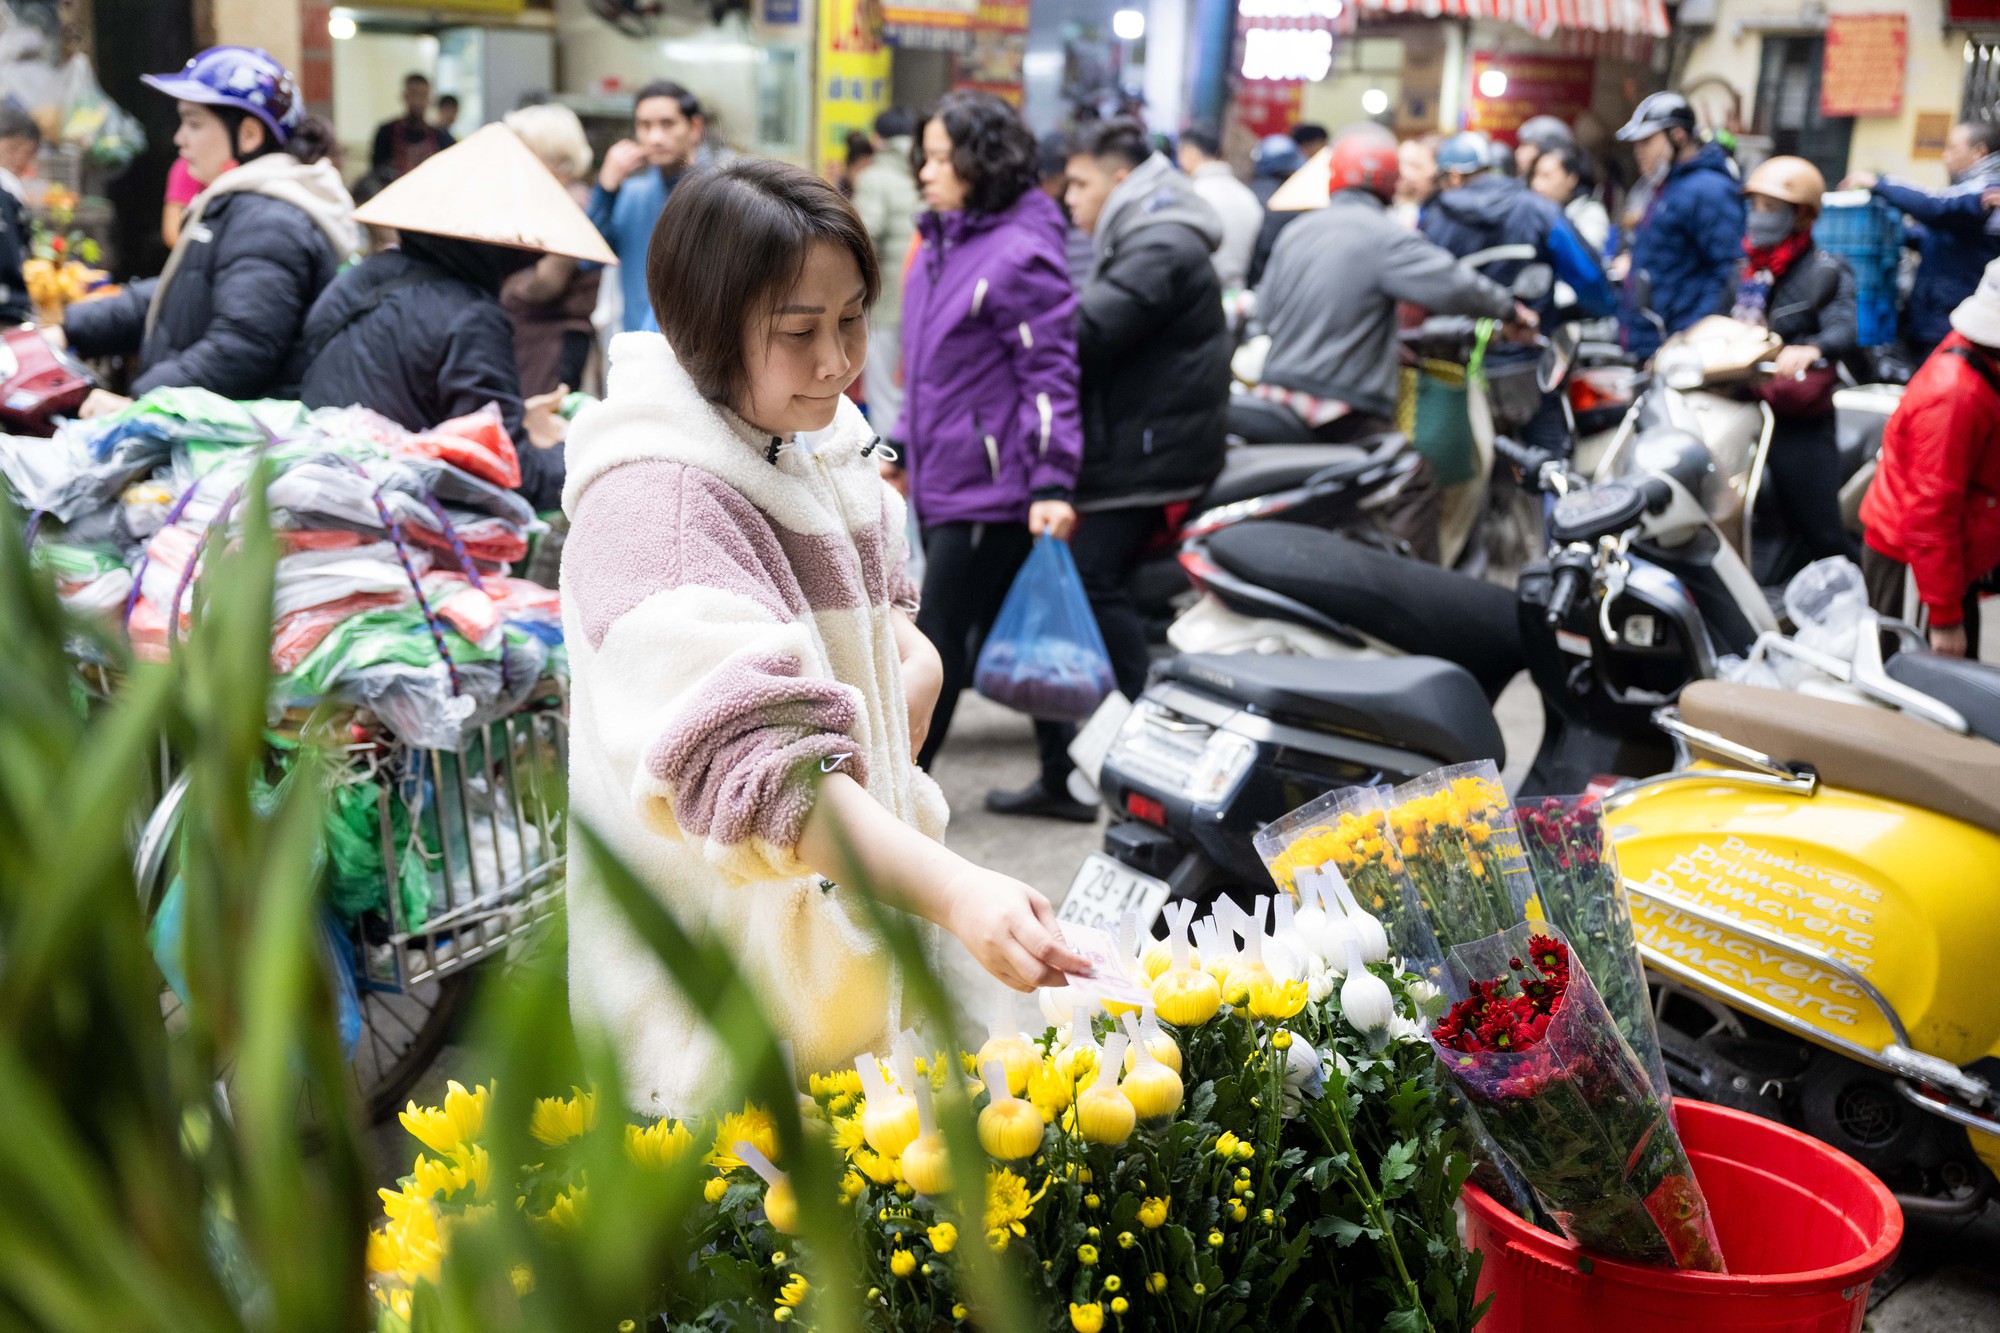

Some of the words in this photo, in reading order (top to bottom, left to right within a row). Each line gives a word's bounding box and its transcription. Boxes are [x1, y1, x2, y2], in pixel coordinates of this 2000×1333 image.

[1666, 854, 1873, 950] Primavera
[1689, 843, 1874, 925] Primavera
[1720, 835, 1883, 903] Primavera
